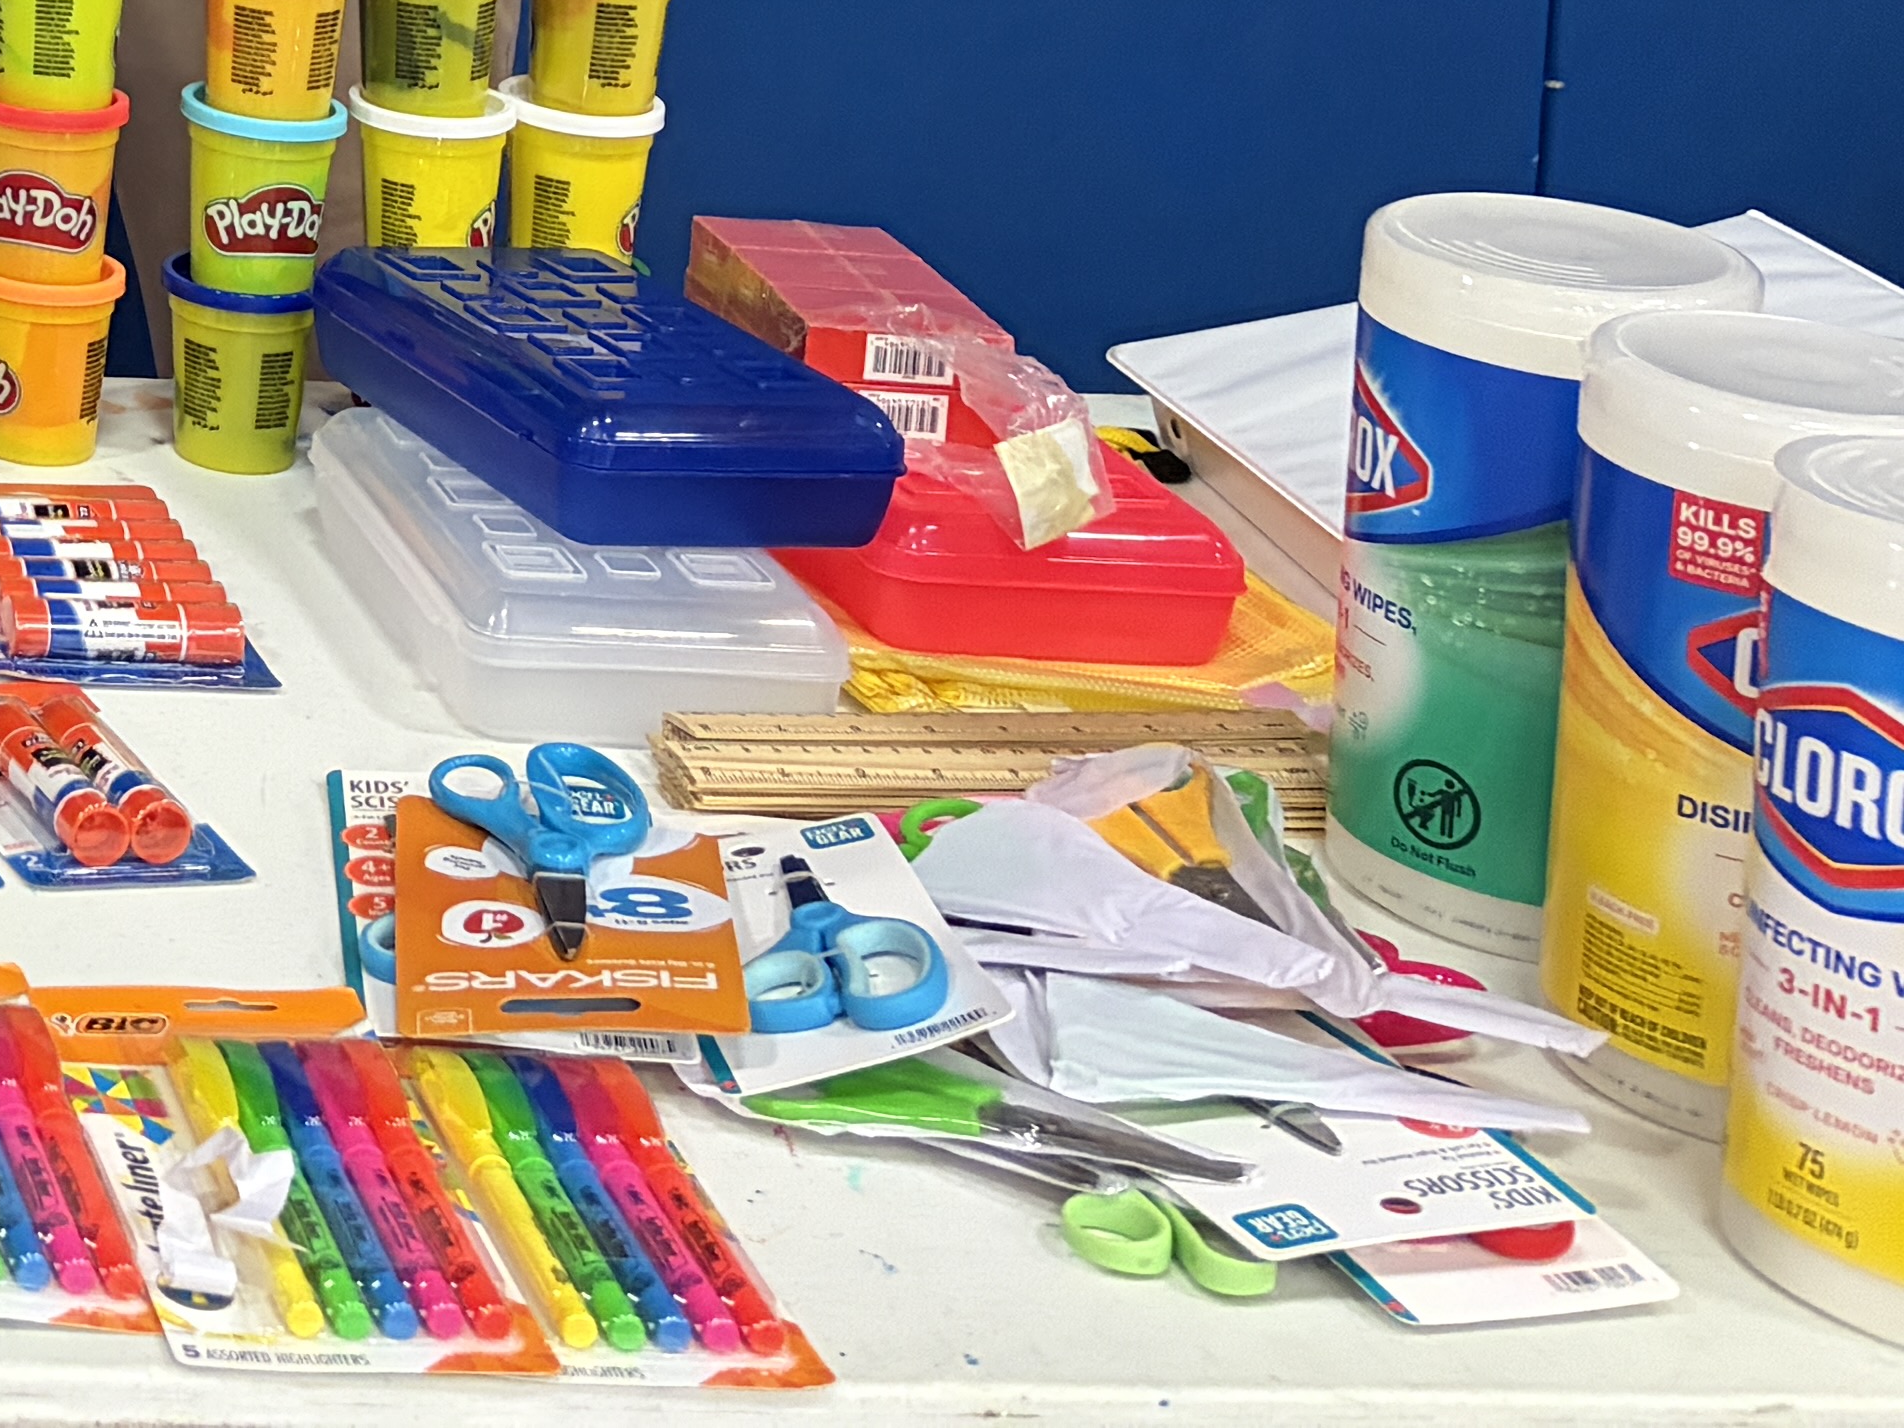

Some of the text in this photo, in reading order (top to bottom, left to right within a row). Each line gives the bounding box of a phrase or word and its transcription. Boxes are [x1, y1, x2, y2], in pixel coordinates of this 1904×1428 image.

[208, 196, 322, 248] Play-Do
[1679, 501, 1758, 540] KILLS
[1676, 524, 1755, 564] 99.9%
[1676, 549, 1693, 563] OF
[1675, 561, 1751, 589] & BACTERIA
[349, 779, 410, 794] KIDS'
[1754, 707, 1904, 848] CLOR
[350, 795, 398, 809] SCIS
[365, 827, 379, 839] 2
[816, 828, 865, 844] GEAR
[21, 854, 40, 868] 2
[360, 859, 391, 873] 4+
[1391, 836, 1477, 878] Do Not Flush
[362, 874, 391, 883] Ages
[373, 896, 387, 911] 5
[424, 969, 718, 992] FISKARS
[1777, 966, 1882, 1034] 3-IN-1
[85, 1017, 160, 1032] BIC
[1773, 1035, 1877, 1096] FRESHENS
[1800, 1025, 1904, 1083] DEODORIZ
[1811, 1103, 1880, 1145] LEMON
[1795, 1140, 1827, 1182] 75
[1404, 1165, 1537, 1199] SCISSORS
[1492, 1184, 1562, 1210] KIDS'
[1247, 1209, 1309, 1234] GEAR
[182, 1344, 371, 1366] 5 ASSORTED HIGHLIGHTERS
